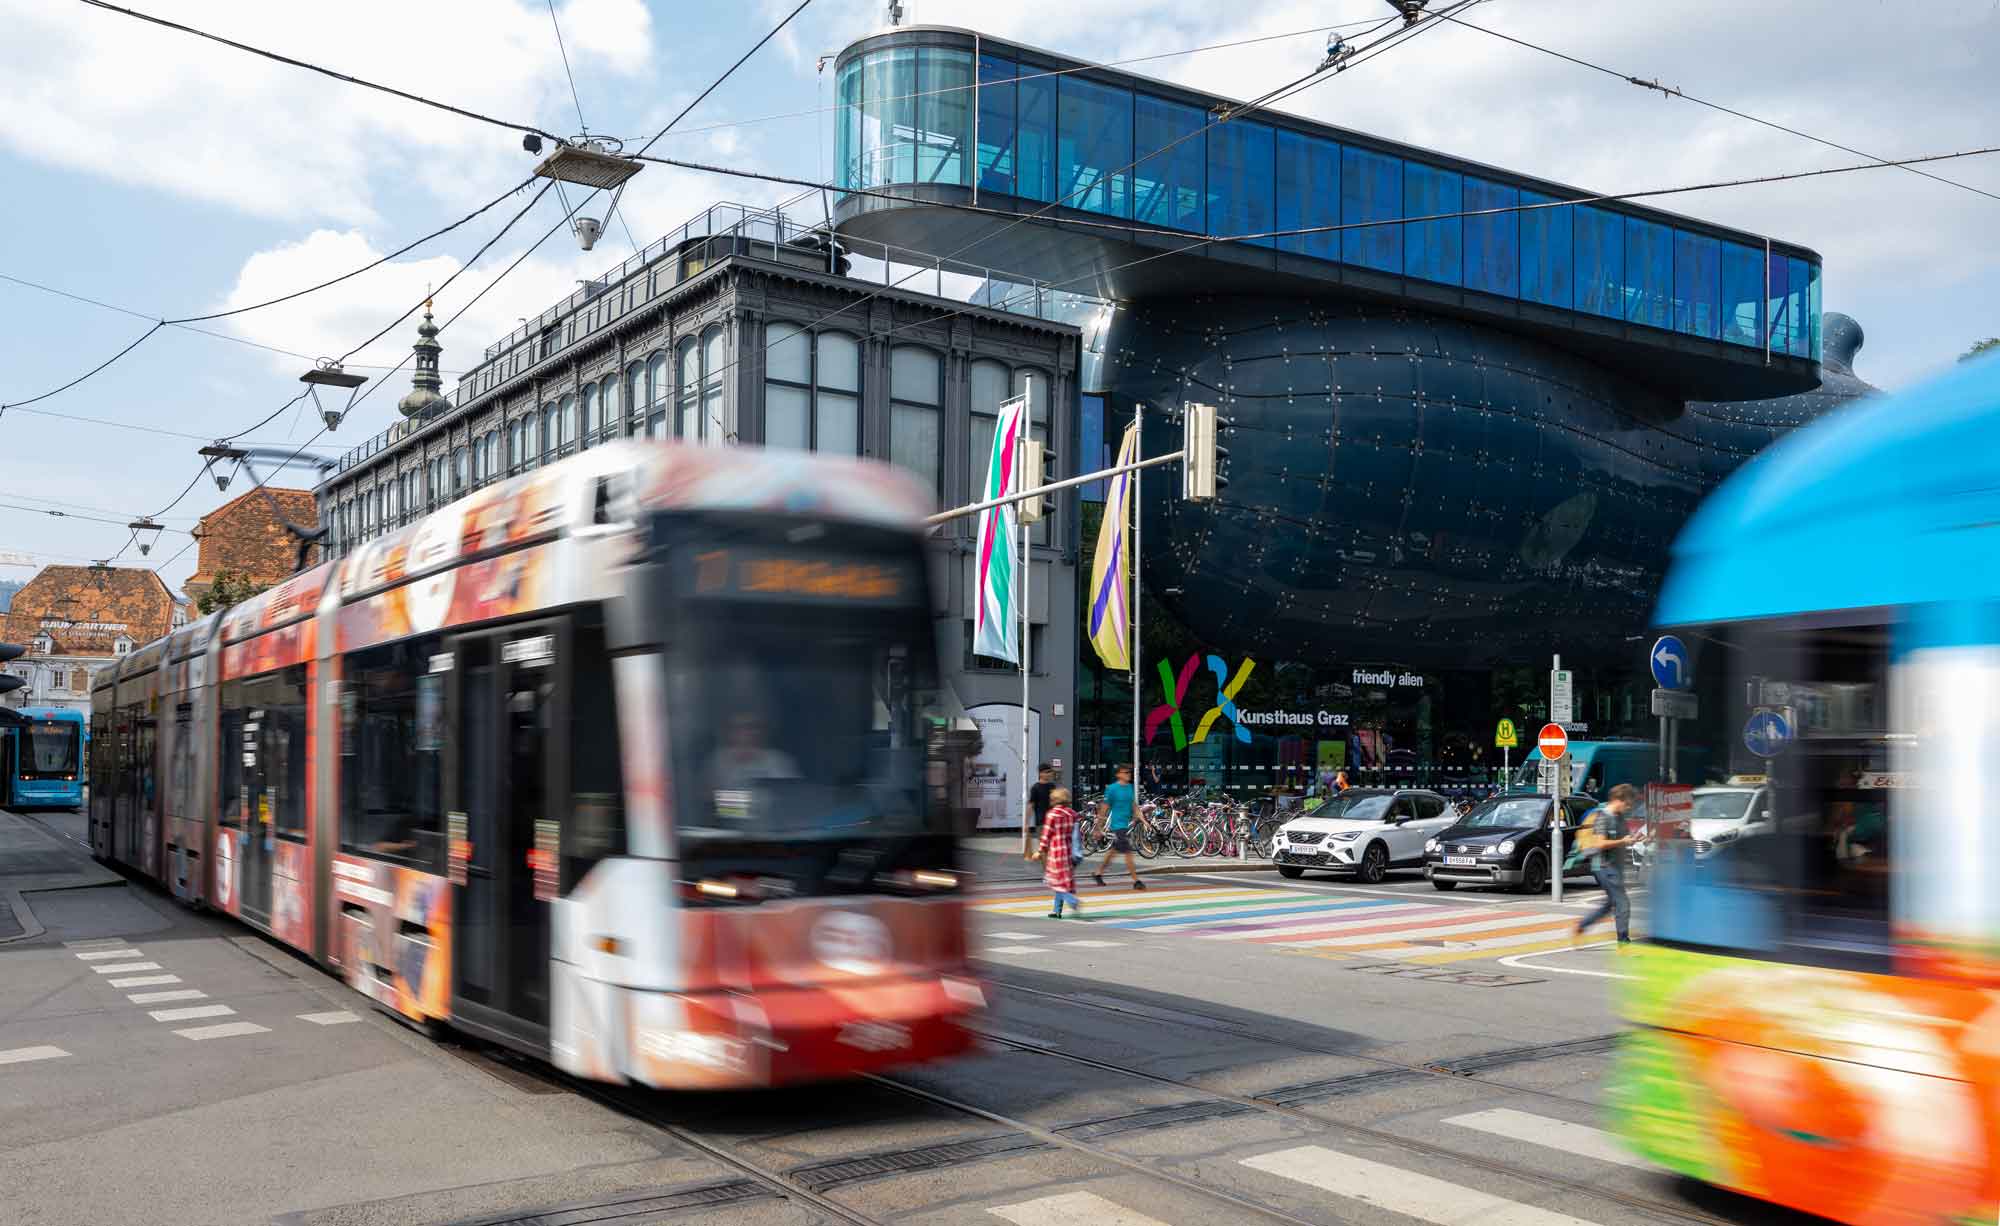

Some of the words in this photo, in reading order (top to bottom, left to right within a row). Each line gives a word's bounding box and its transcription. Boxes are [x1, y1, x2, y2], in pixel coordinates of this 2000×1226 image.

[1352, 669, 1396, 688] friendly
[1398, 672, 1424, 687] alien
[1236, 708, 1314, 725] Kunsthaus
[1317, 710, 1349, 726] Graz
[1501, 721, 1510, 737] H
